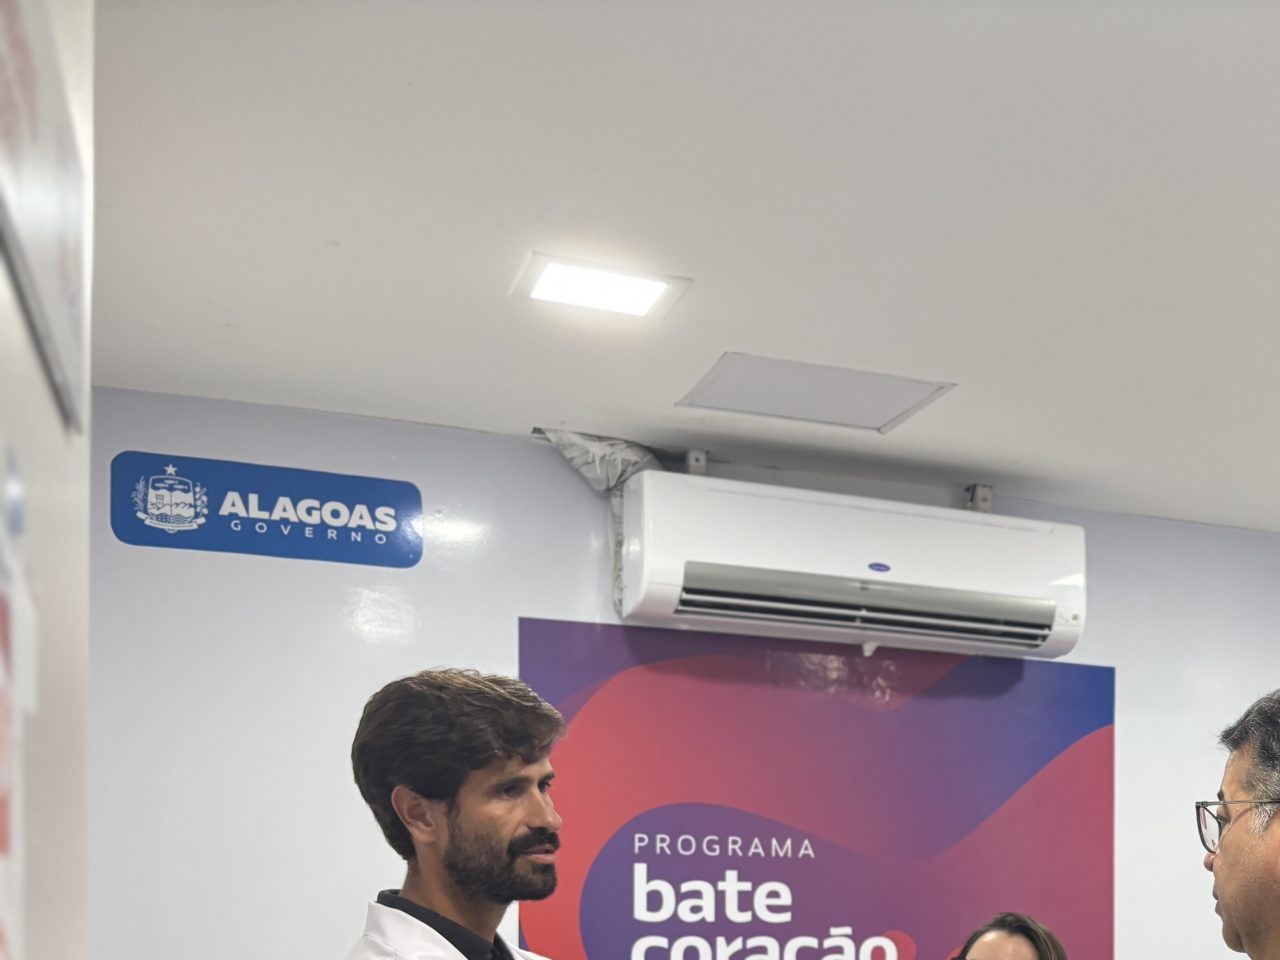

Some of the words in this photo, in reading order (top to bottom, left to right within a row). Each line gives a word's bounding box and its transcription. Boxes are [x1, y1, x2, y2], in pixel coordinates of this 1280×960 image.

[219, 491, 397, 533] ALAGOAS
[230, 519, 387, 545] GOVERNO
[633, 833, 816, 858] PROGRAMA
[633, 862, 792, 923] bate
